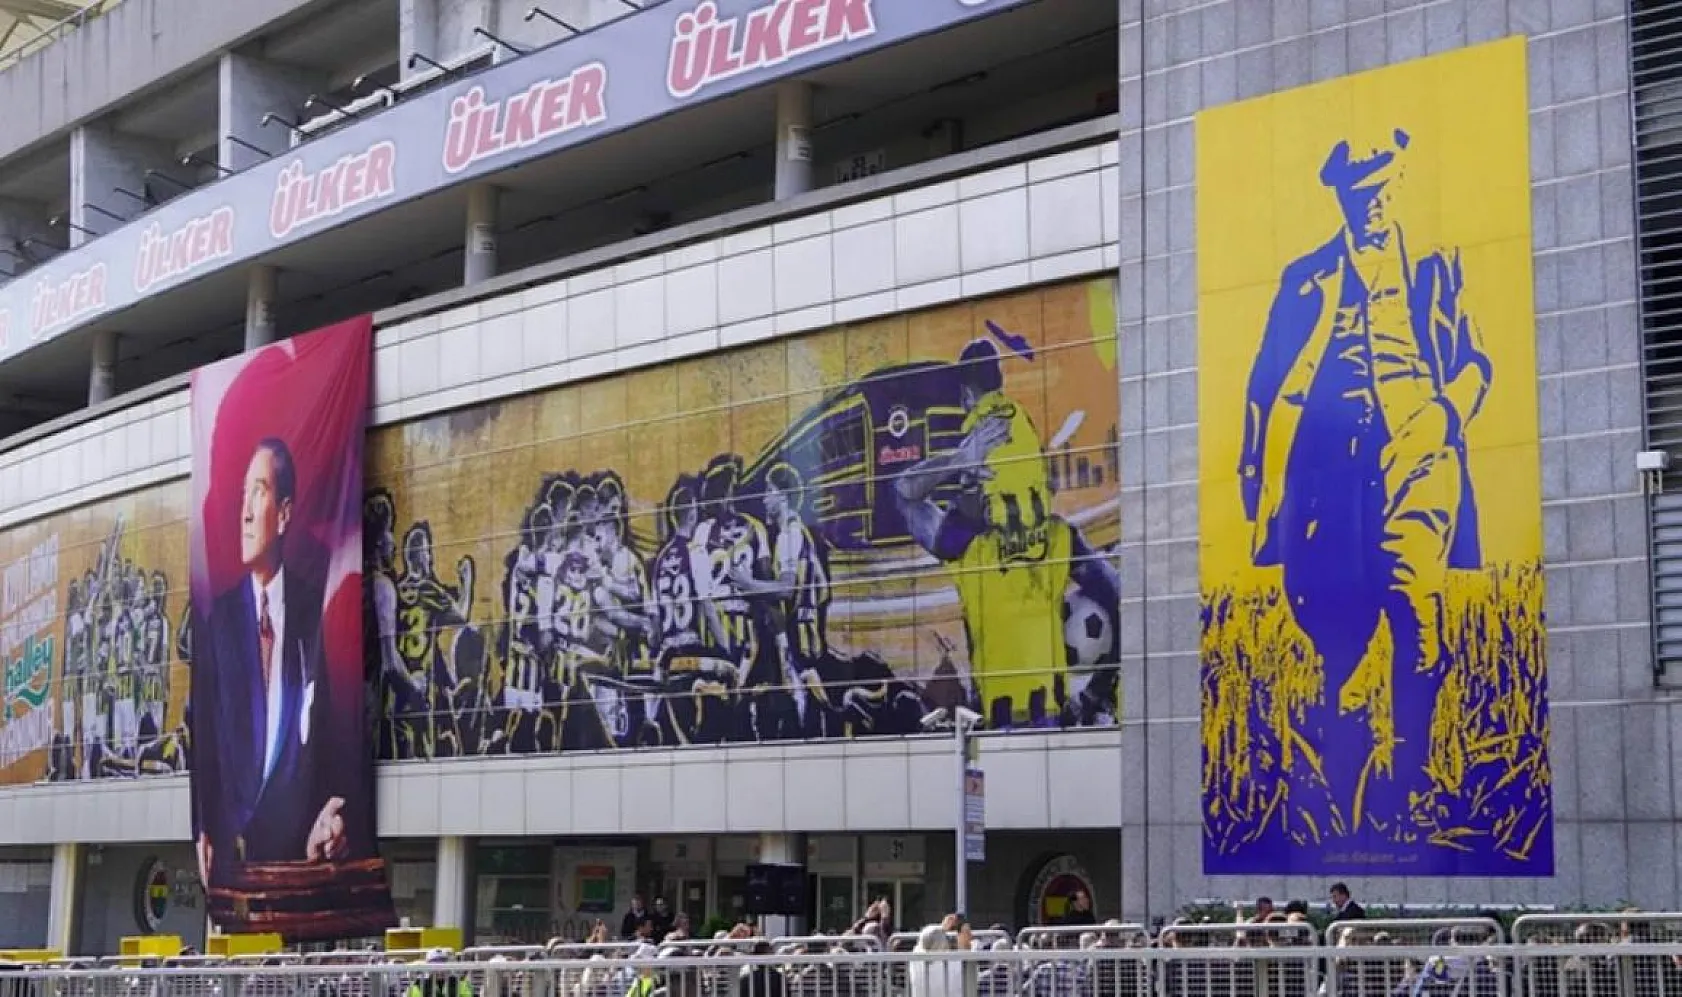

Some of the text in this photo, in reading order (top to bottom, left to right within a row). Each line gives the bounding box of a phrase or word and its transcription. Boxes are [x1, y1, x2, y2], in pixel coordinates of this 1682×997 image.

[667, 0, 877, 98] ÜLKER
[443, 61, 608, 173] ÜLKER
[269, 141, 395, 238] ÜLKER
[134, 206, 235, 294] ÜLKER
[30, 262, 107, 341] ÜLKER
